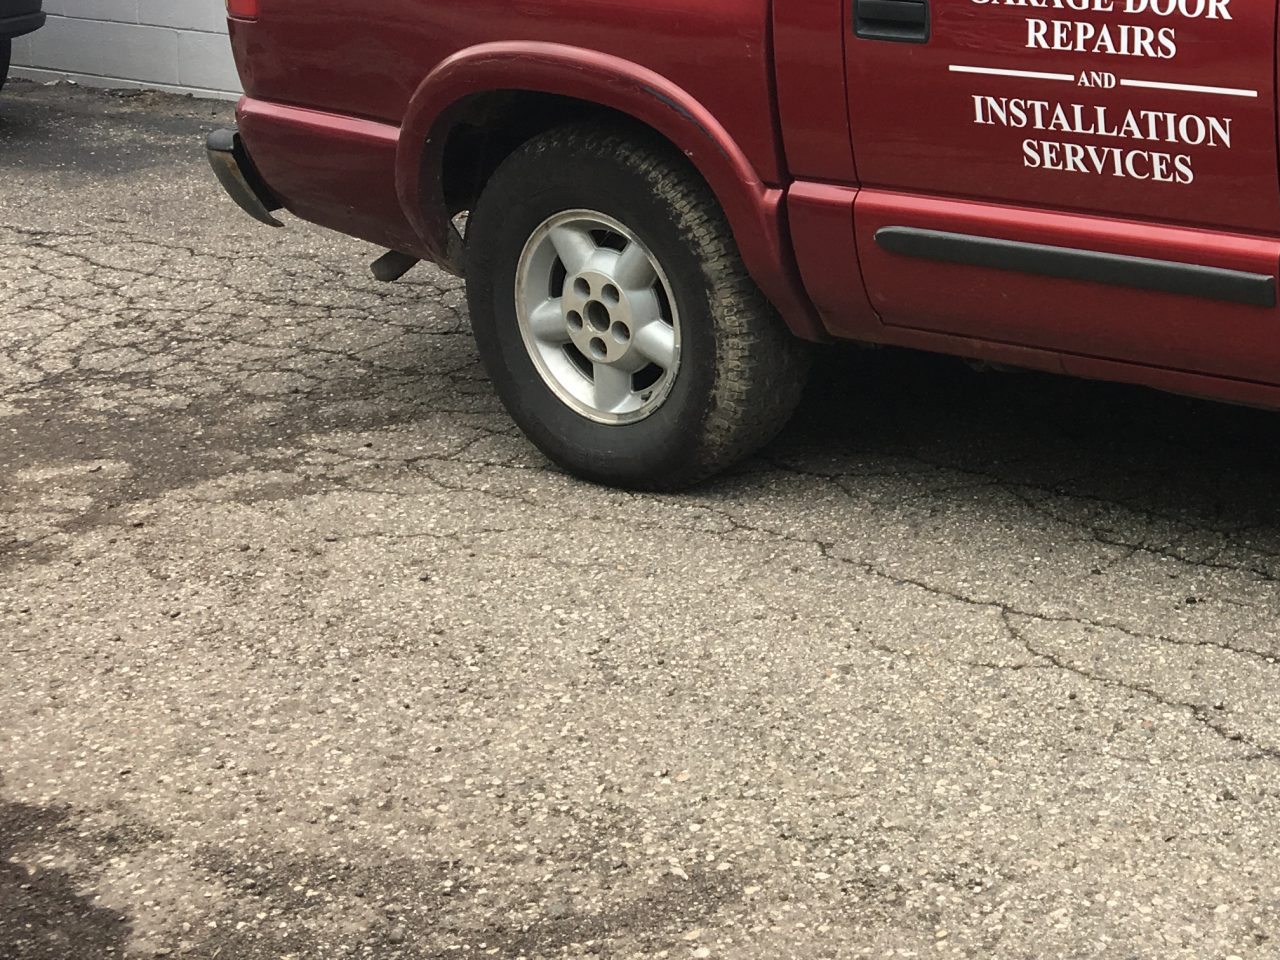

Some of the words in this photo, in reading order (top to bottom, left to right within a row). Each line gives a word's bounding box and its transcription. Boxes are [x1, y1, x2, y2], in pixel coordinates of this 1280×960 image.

[1025, 18, 1177, 59] REPAIRS
[1077, 71, 1116, 89] AND
[971, 95, 1232, 148] INSTALLATION
[1022, 139, 1194, 184] SERVICES
